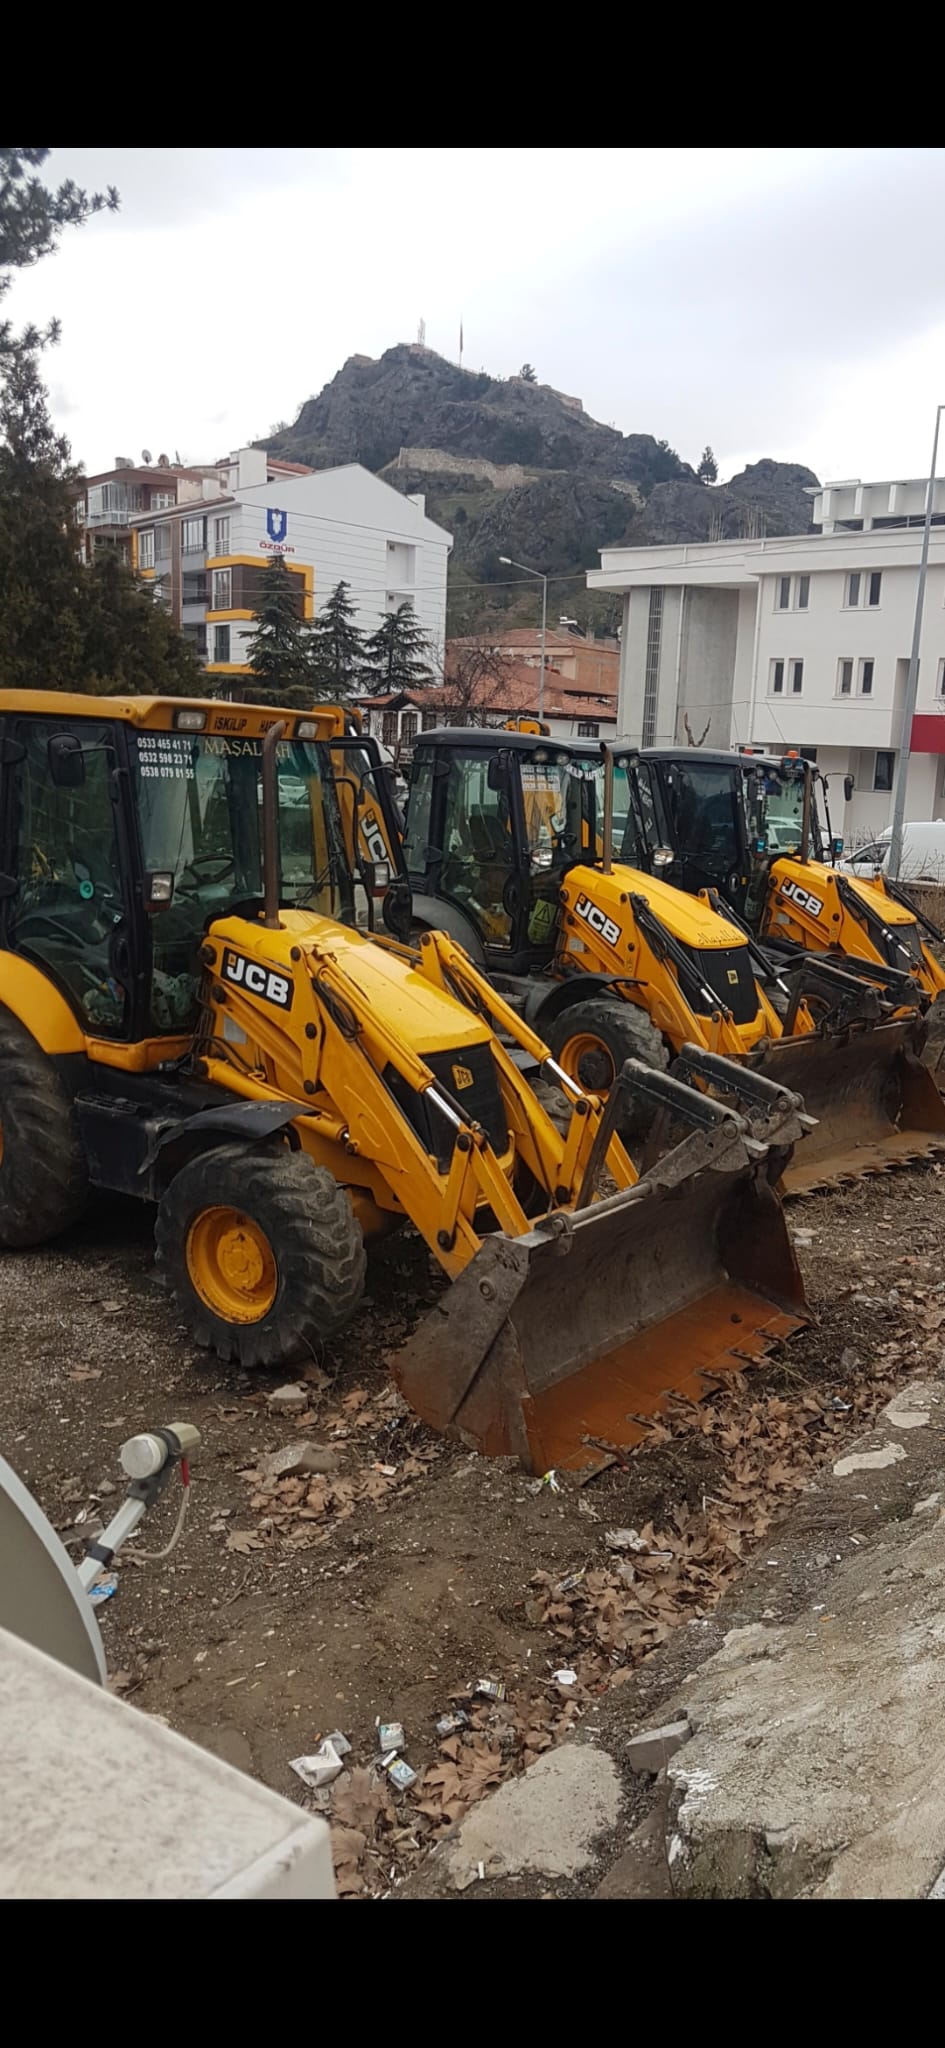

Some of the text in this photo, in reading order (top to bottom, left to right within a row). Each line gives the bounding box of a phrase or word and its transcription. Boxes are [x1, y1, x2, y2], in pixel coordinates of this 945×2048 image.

[137, 737, 156, 748] 0533
[172, 740, 181, 750] 41
[182, 740, 192, 751] 71
[139, 752, 157, 763] 0532
[174, 754, 183, 765] 23
[184, 754, 193, 766] 71
[185, 769, 194, 780] 55
[780, 883, 822, 916] JCB
[575, 901, 620, 945] JCB
[226, 957, 289, 1004] JCB
